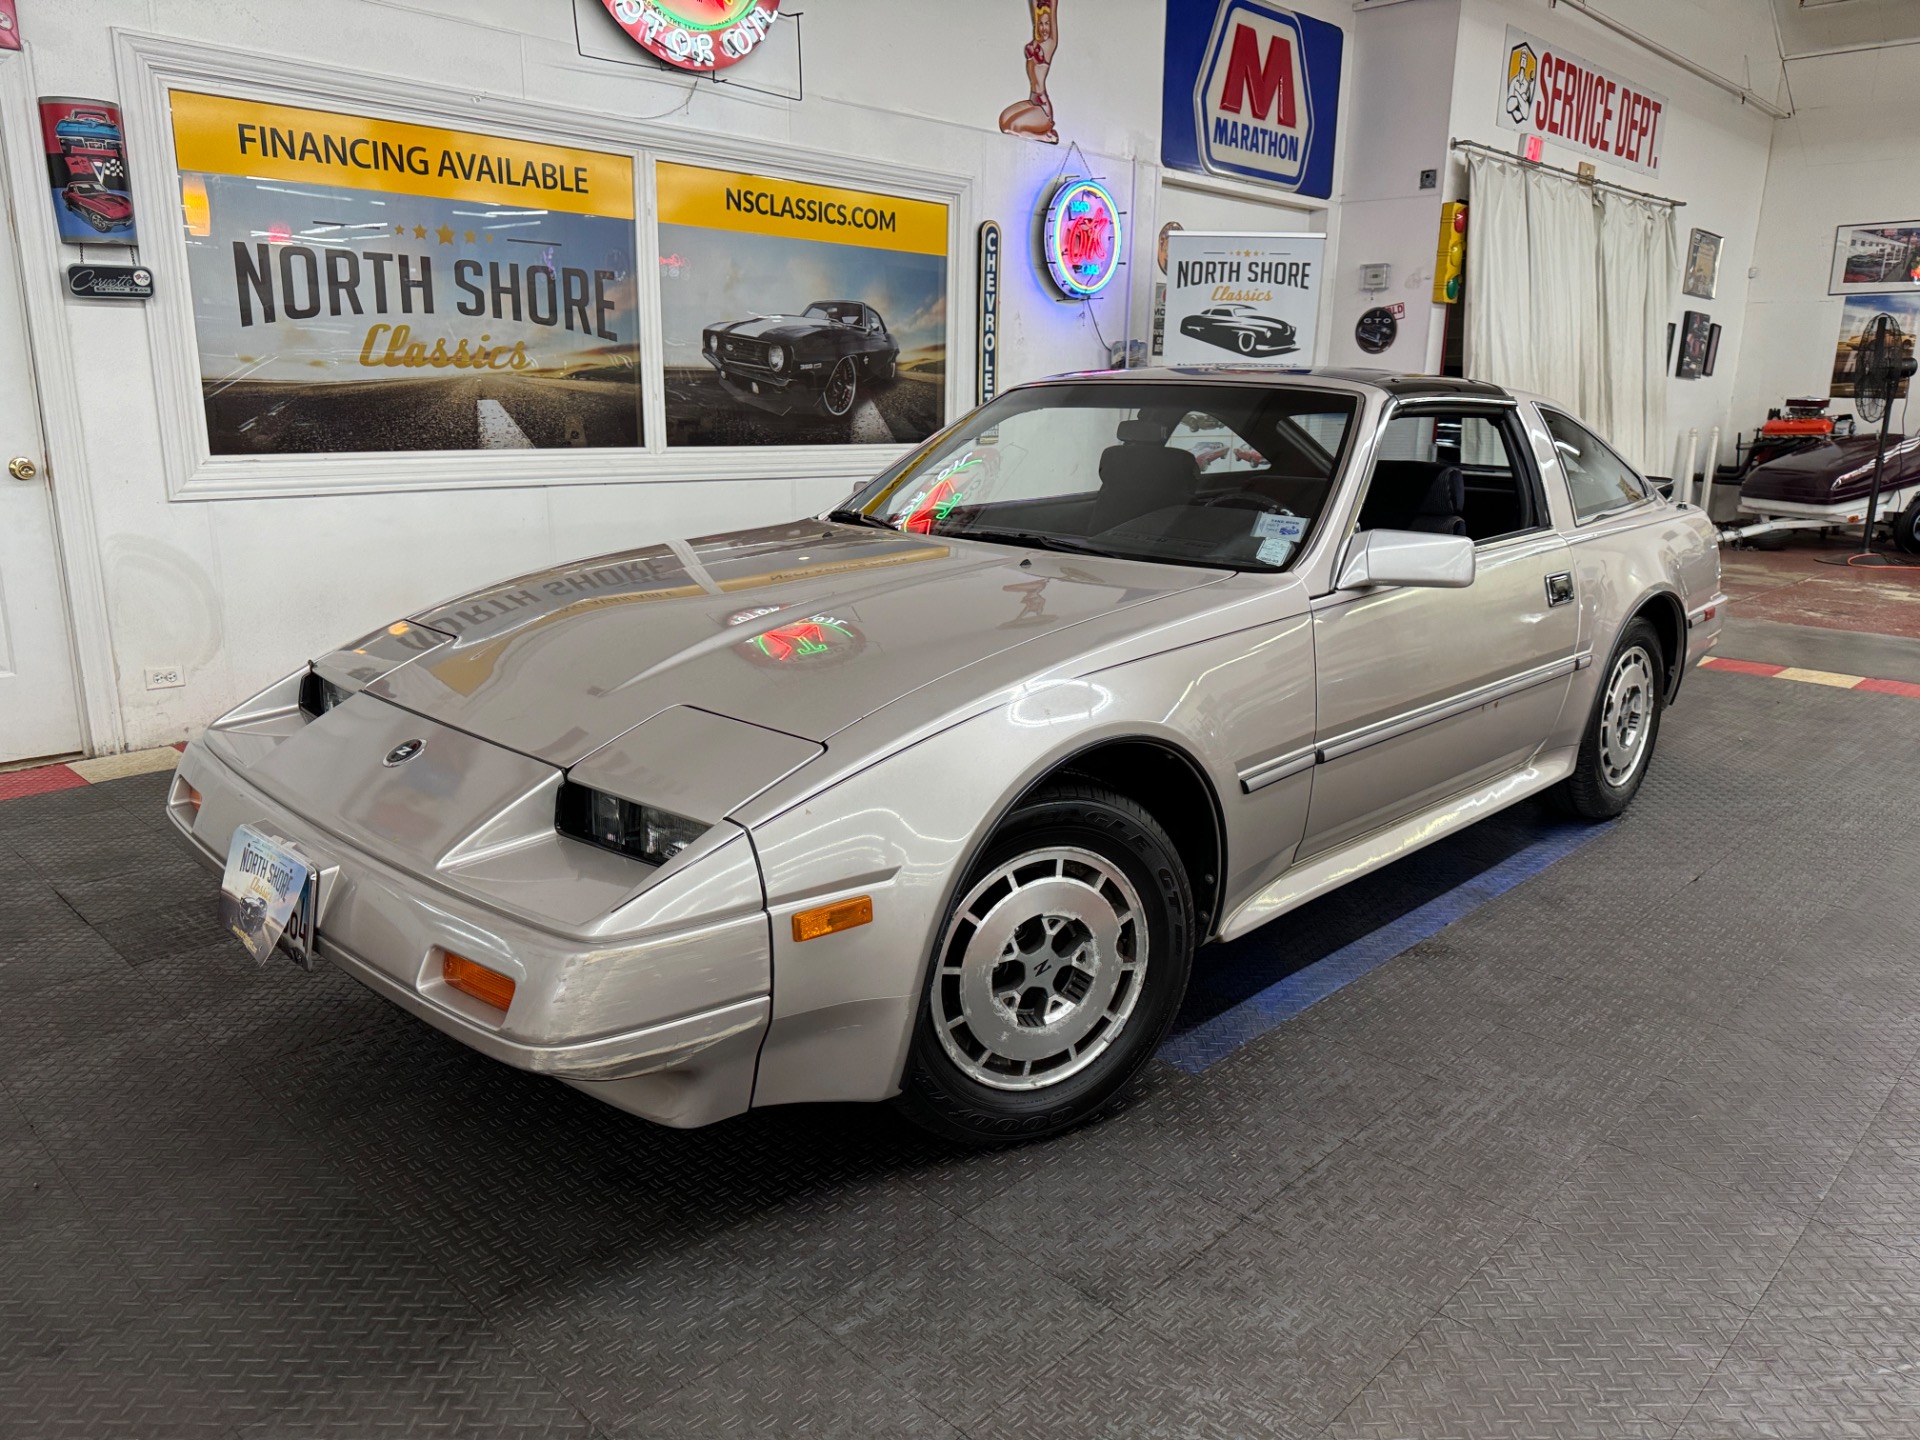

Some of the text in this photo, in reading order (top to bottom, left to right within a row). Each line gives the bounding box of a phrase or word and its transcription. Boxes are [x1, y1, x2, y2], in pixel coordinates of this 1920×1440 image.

[721, 6, 778, 58] OIL
[1219, 22, 1296, 129] M
[1535, 51, 1662, 169] SERVICE DEPT.
[238, 123, 589, 194] FINANCING AVAILABLE
[1213, 117, 1299, 162] MARATHON
[726, 187, 896, 232] NSCLASSICS.COM
[1067, 207, 1109, 267] OK
[71, 269, 135, 291] Corvette
[233, 241, 618, 342] NORTH SHORE
[1177, 260, 1312, 290] NORTH SHORE
[1211, 285, 1273, 301] Classics
[359, 323, 532, 370] Classics
[240, 846, 294, 903] NORTH SHORE
